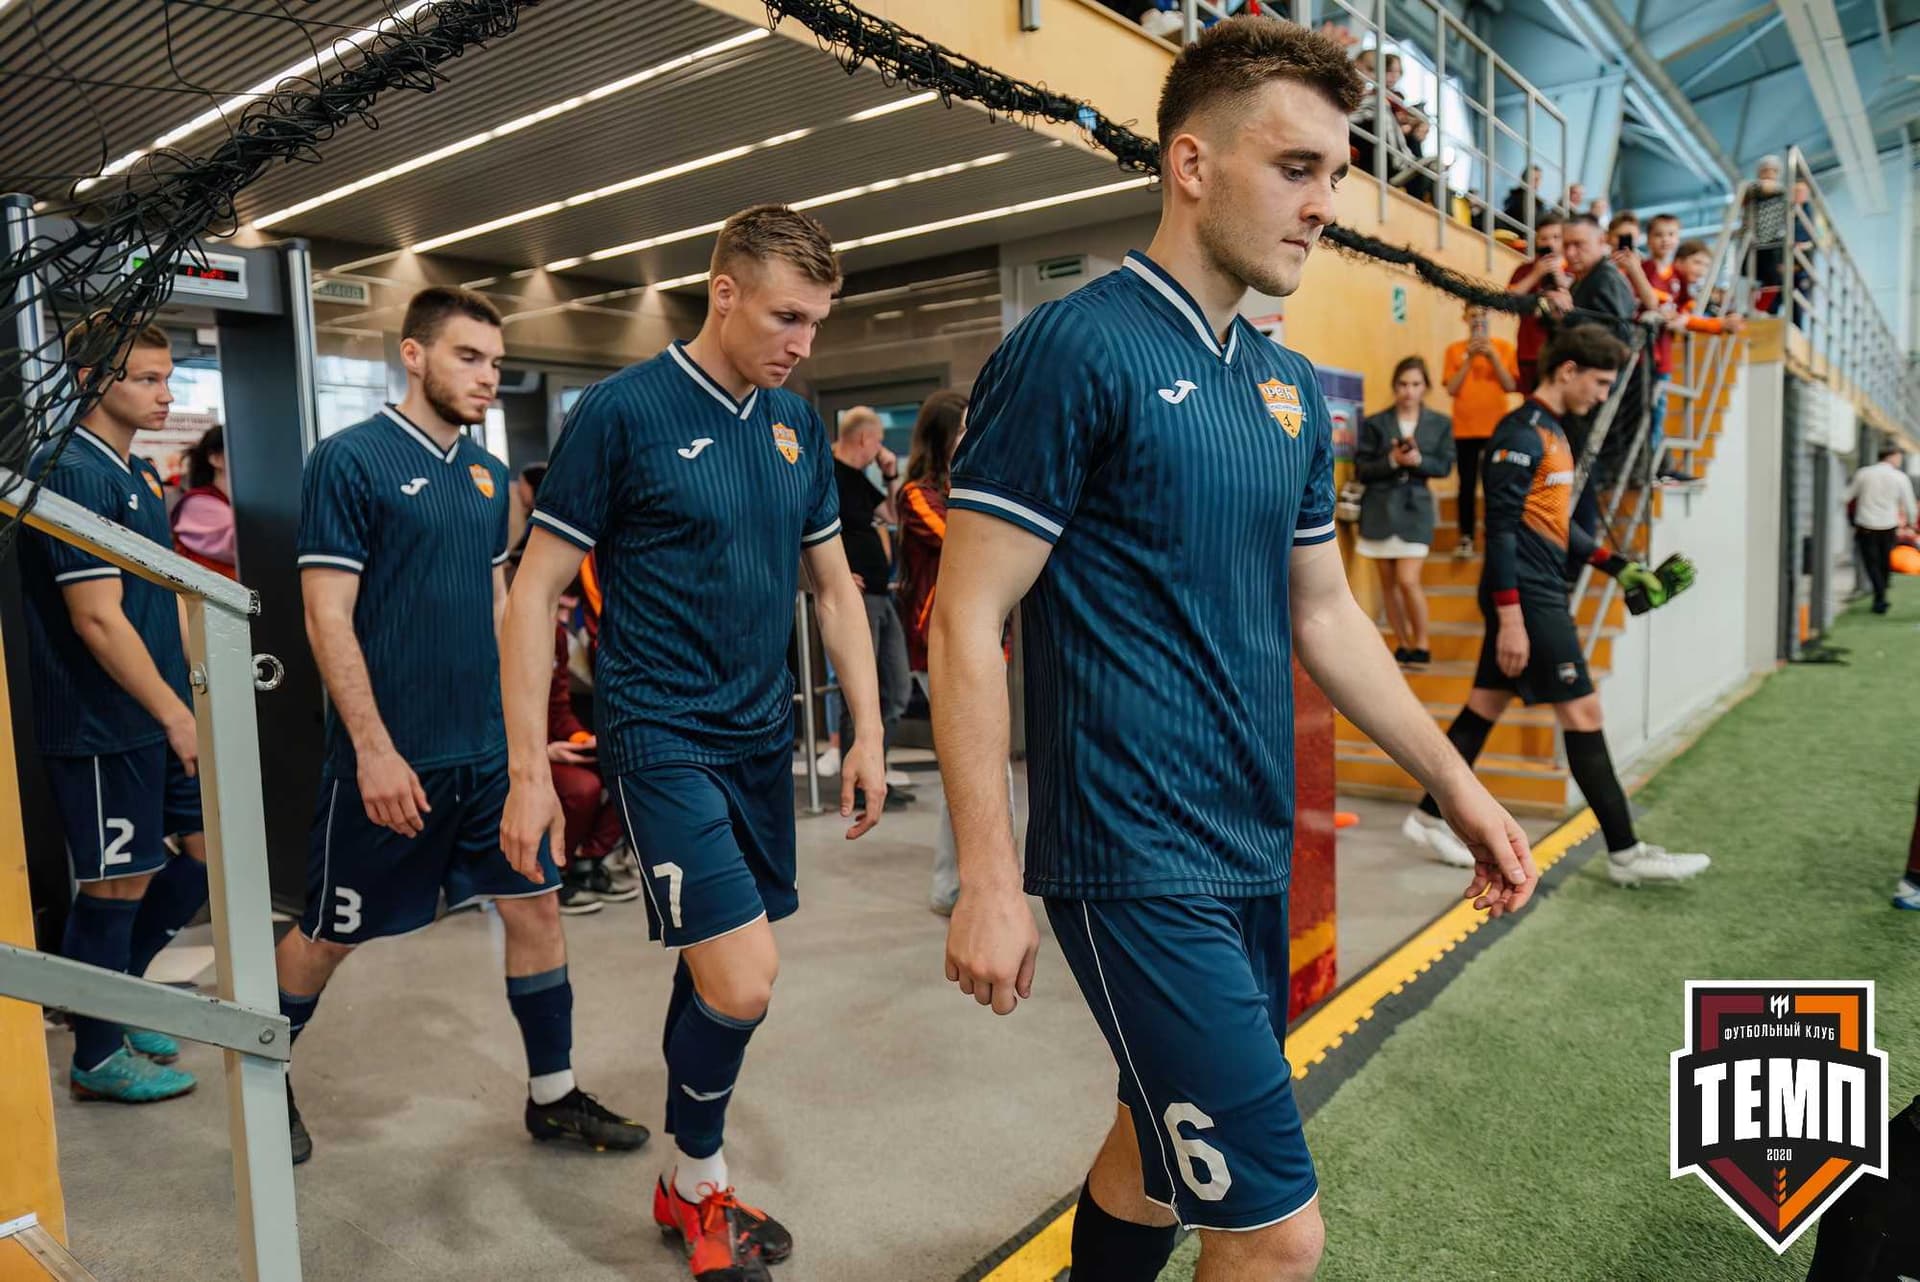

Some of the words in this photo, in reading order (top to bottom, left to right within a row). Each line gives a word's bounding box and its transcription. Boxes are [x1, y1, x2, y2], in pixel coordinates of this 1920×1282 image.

[104, 818, 135, 865] 2
[333, 886, 362, 934] 3
[652, 861, 684, 928] 7
[1163, 1102, 1232, 1201] 6
